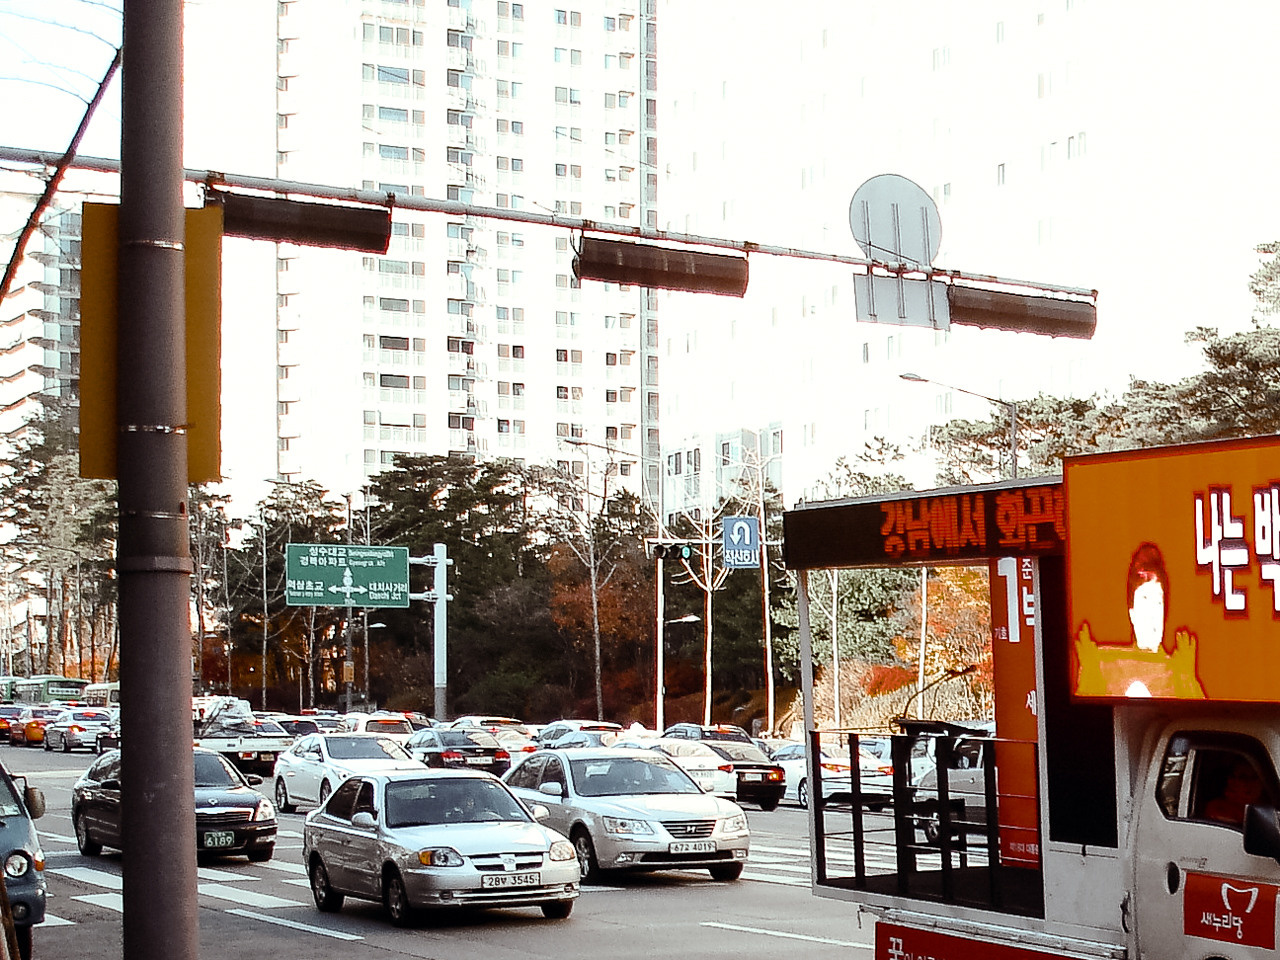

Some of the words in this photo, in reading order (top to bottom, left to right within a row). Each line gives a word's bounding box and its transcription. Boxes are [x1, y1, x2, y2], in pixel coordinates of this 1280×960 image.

[879, 494, 986, 558] 강남에서
[1195, 490, 1248, 611] 나는
[206, 836, 233, 847] 6189
[511, 874, 535, 885] 3545
[1201, 911, 1244, 940] 새누리당
